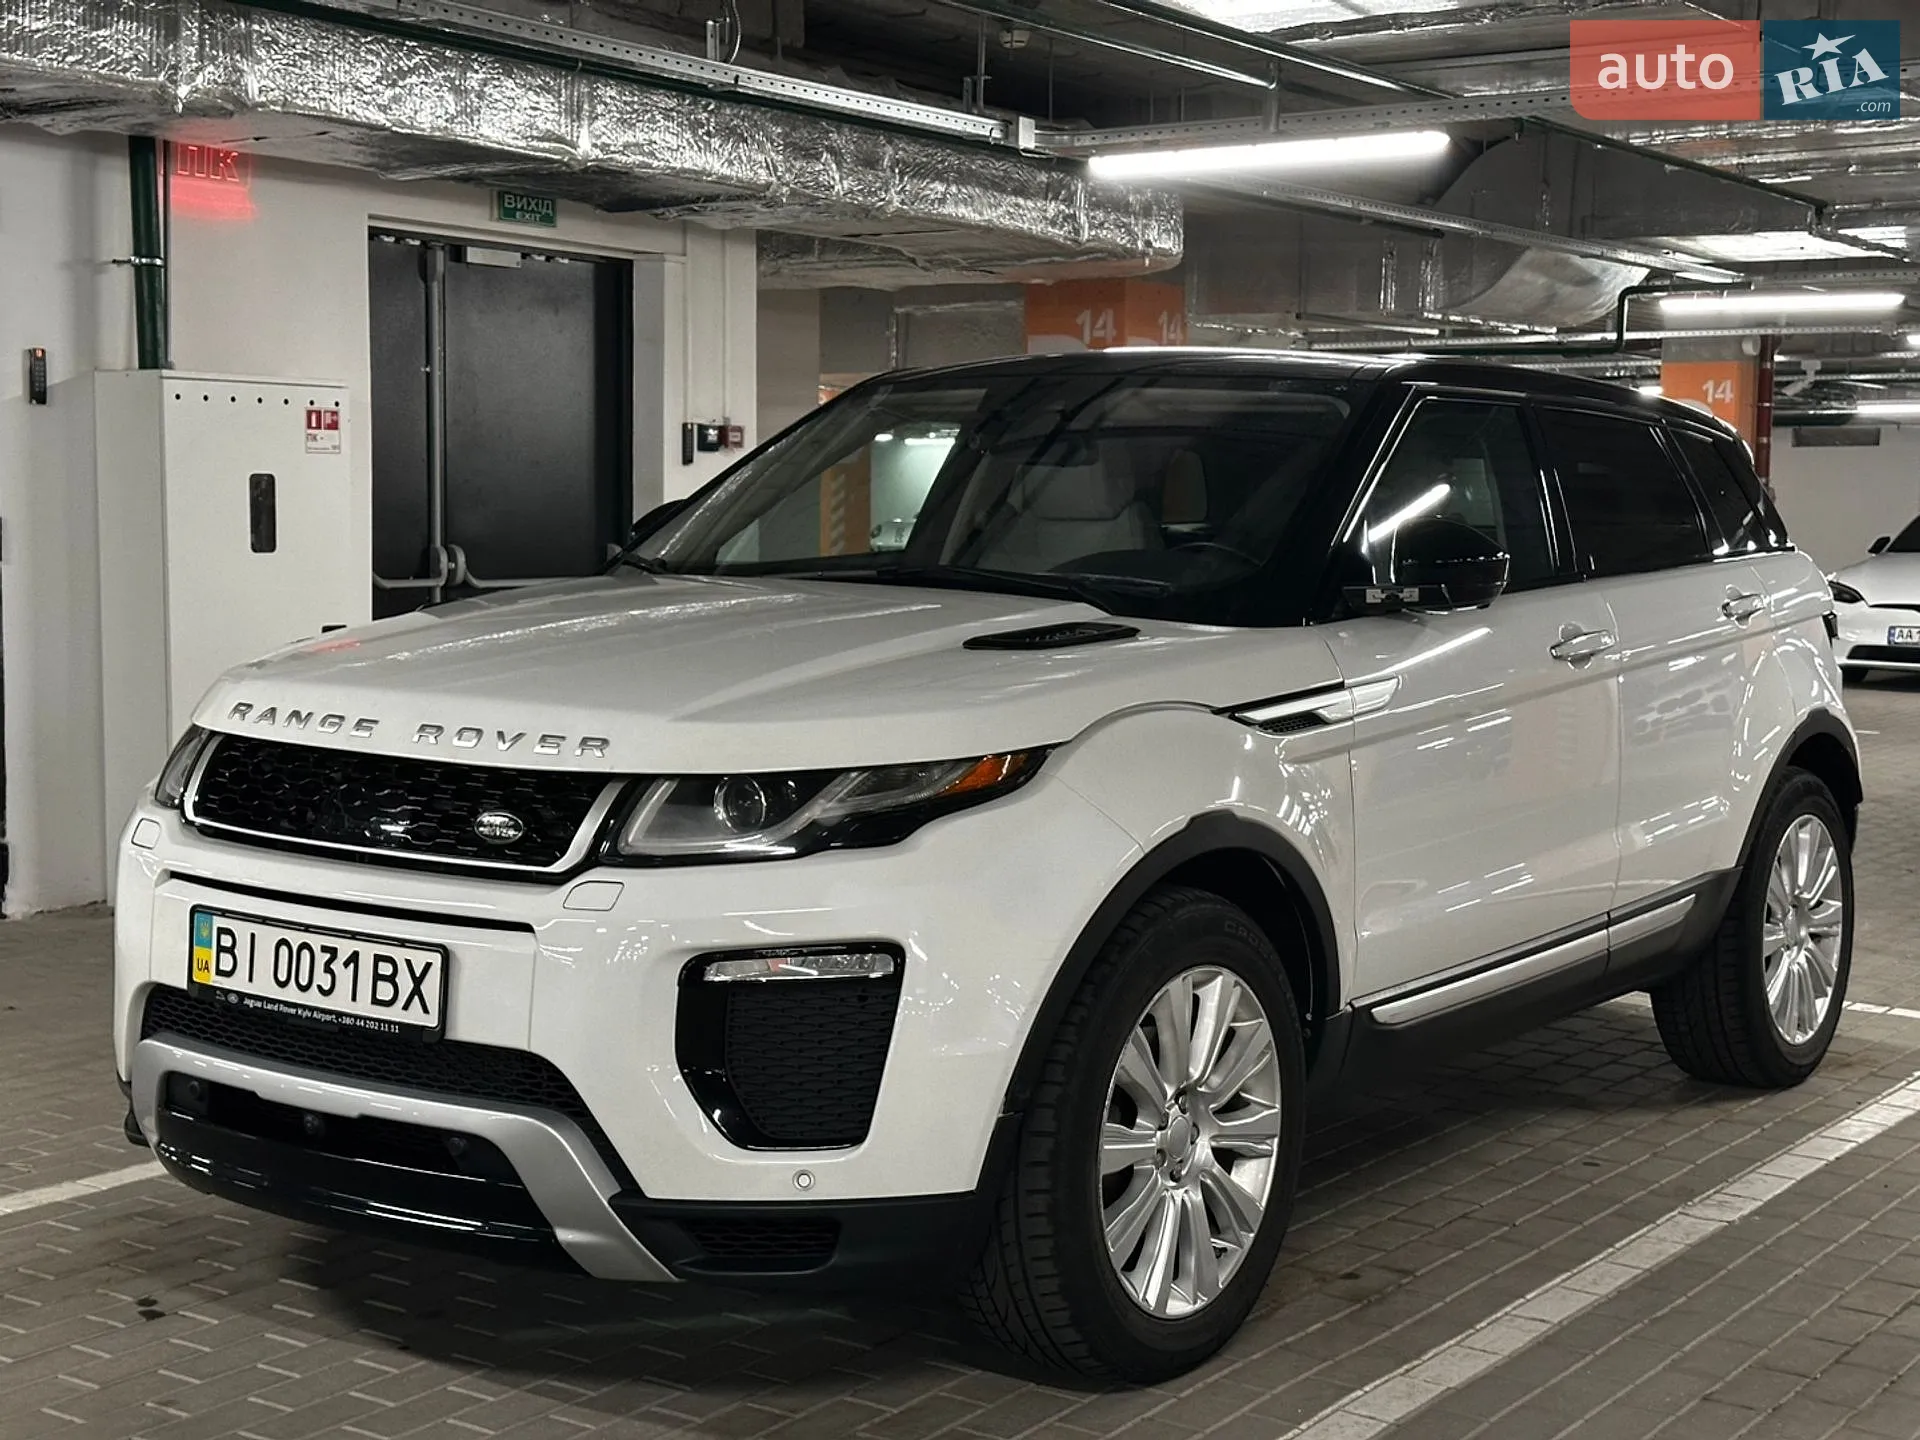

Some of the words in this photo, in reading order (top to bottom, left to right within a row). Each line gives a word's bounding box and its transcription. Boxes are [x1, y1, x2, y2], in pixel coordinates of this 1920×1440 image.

[178, 145, 239, 182] ПК
[503, 194, 553, 217] ВИХІД
[515, 211, 541, 222] EXIT
[1075, 308, 1117, 345] 14
[1158, 310, 1184, 345] 14
[1702, 379, 1734, 404] 14
[227, 701, 380, 738] RANGE
[411, 723, 611, 758] ROVER
[197, 957, 210, 973] UA
[263, 1000, 279, 1012] Land
[279, 1003, 297, 1015] Rover
[355, 1018, 365, 1027] 44
[365, 1020, 379, 1030] 202
